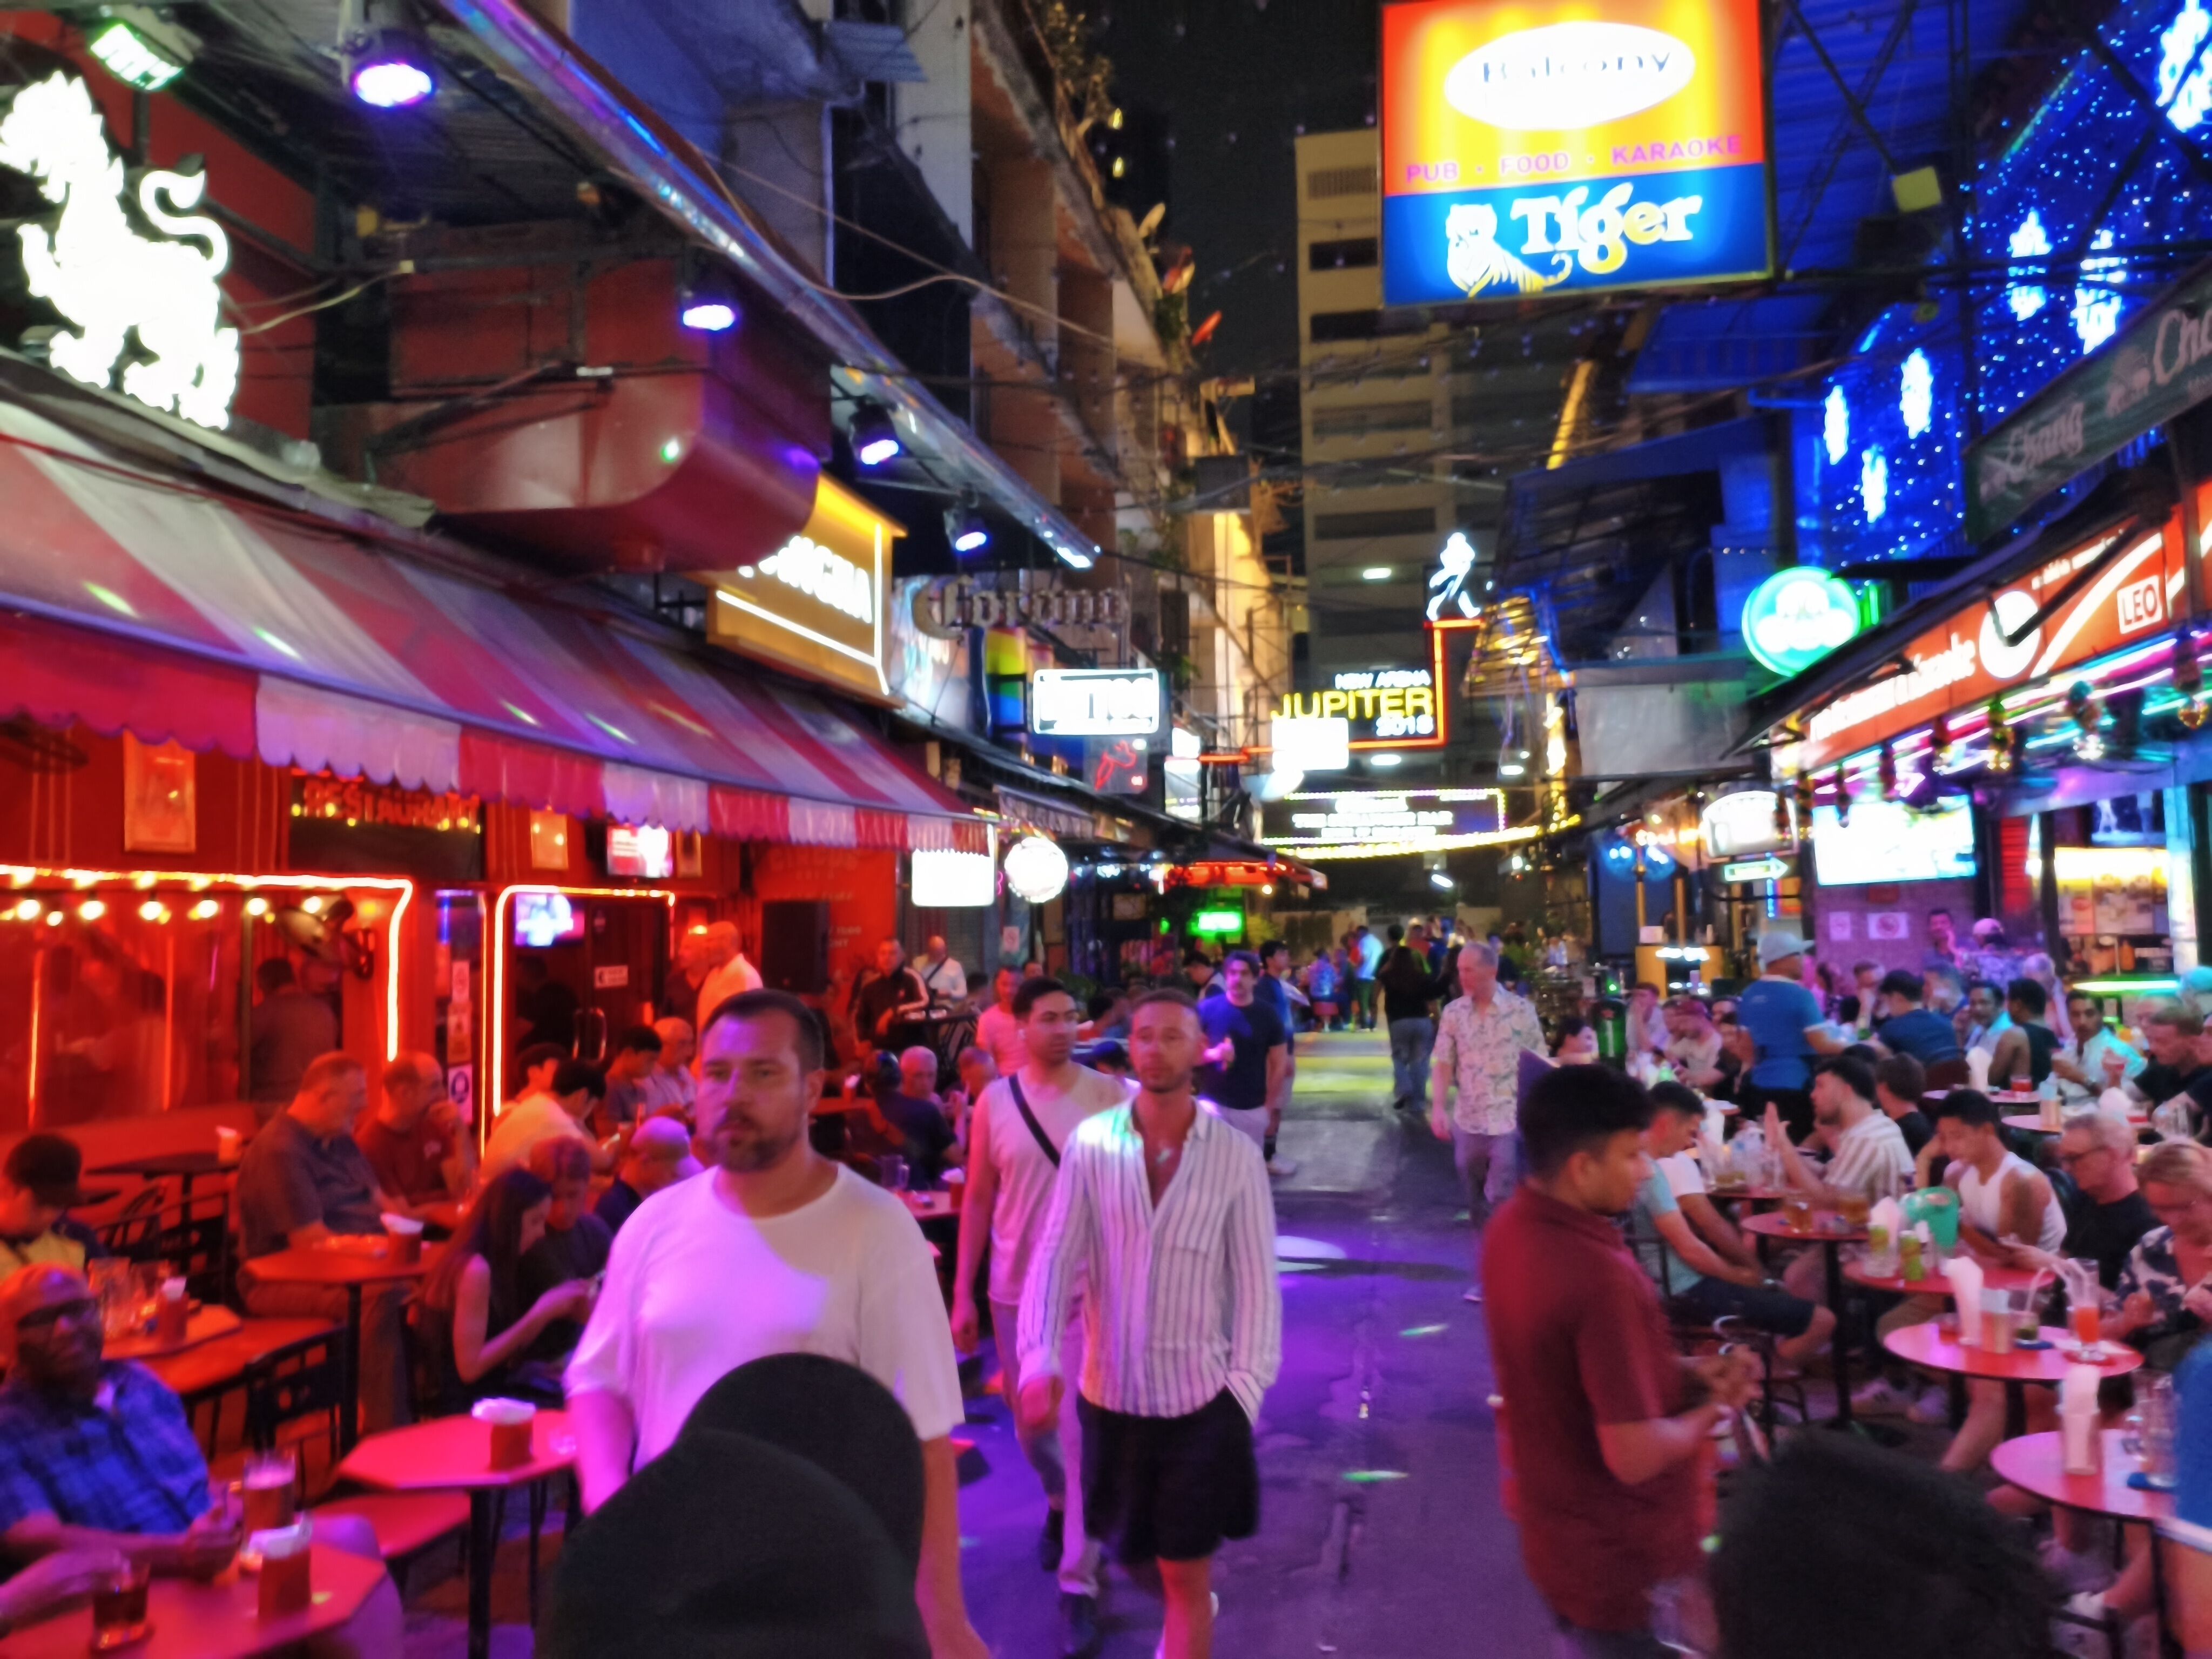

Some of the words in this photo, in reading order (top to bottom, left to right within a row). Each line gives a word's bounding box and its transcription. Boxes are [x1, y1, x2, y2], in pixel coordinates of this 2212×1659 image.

[1405, 161, 1459, 184] PUB
[1499, 152, 1570, 176] FOOD
[1610, 134, 1744, 165] KARAOKE
[1509, 181, 1703, 274] Tiger
[2121, 583, 2158, 626] LEO
[1270, 687, 1434, 720] JUPITER
